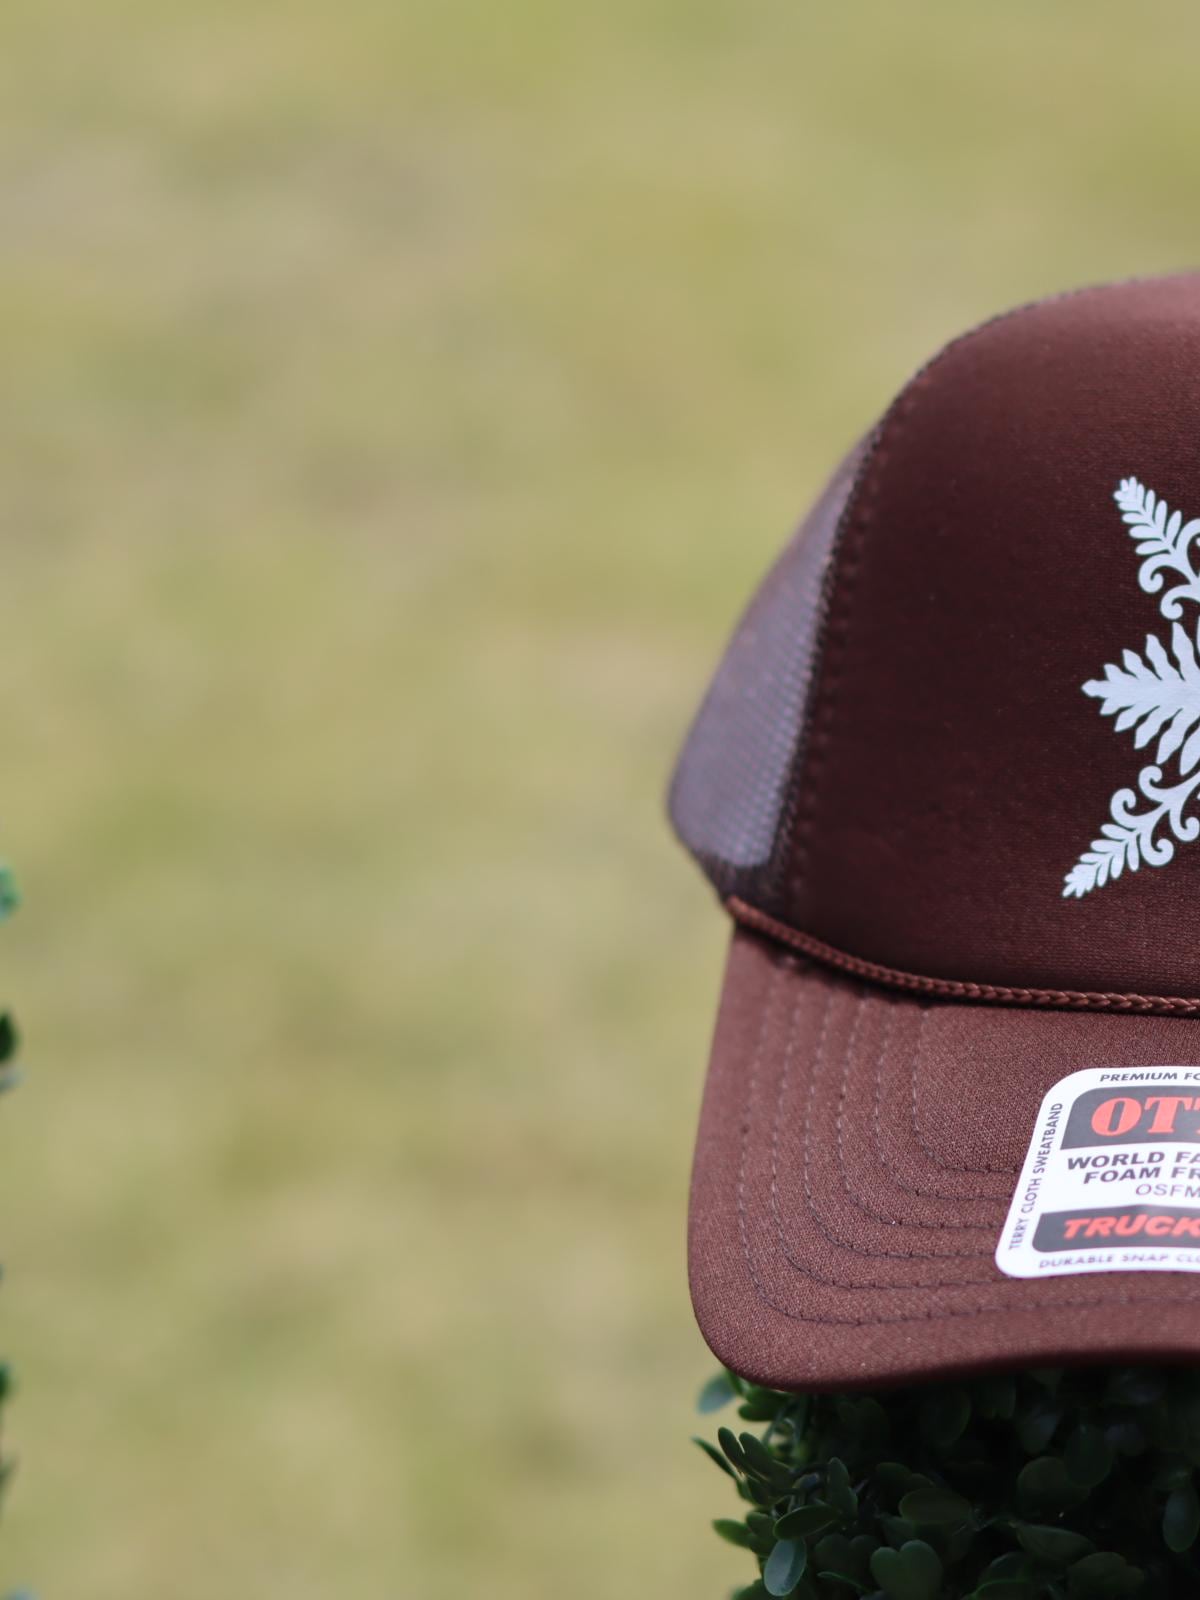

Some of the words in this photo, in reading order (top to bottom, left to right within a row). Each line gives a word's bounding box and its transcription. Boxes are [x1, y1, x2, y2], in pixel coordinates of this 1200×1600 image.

[1099, 1072, 1178, 1083] PREMIUM
[1067, 1151, 1165, 1171] WORLD
[1009, 1218, 1028, 1251] TERRY
[1020, 1176, 1042, 1214] CLOTH
[1032, 1102, 1063, 1173] SWEATBAND
[1083, 1167, 1160, 1184] FOAM
[1039, 1255, 1114, 1269] DURABLE
